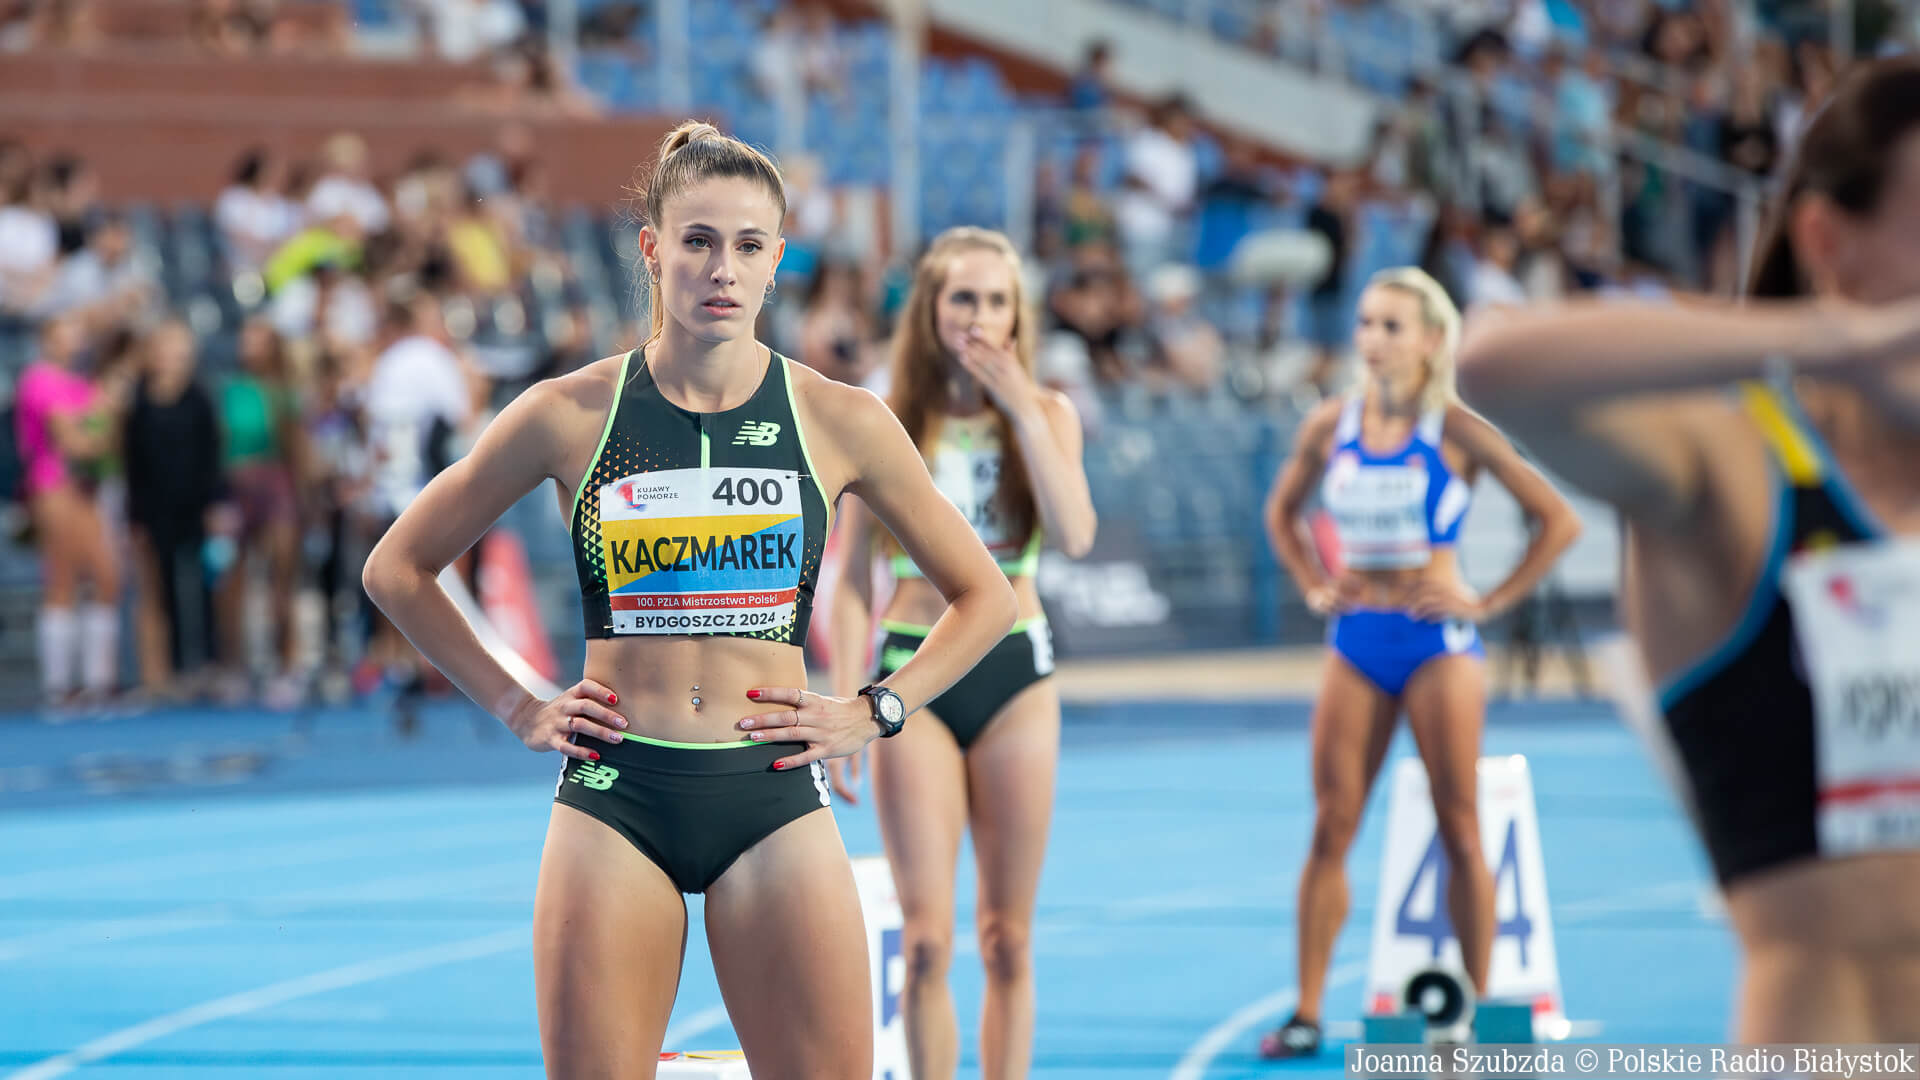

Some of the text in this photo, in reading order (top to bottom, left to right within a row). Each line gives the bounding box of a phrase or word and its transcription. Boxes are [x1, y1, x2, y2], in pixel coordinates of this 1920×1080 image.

[637, 485, 670, 493] KUJAWY
[637, 492, 680, 500] POMORZE
[712, 477, 783, 506] 400
[610, 533, 797, 575] KACZMAREK
[636, 594, 778, 607] 100. PZLA Mistrzostwa Polski
[635, 611, 776, 628] BYDGOSZCZ 2024
[1396, 824, 1459, 960] 4
